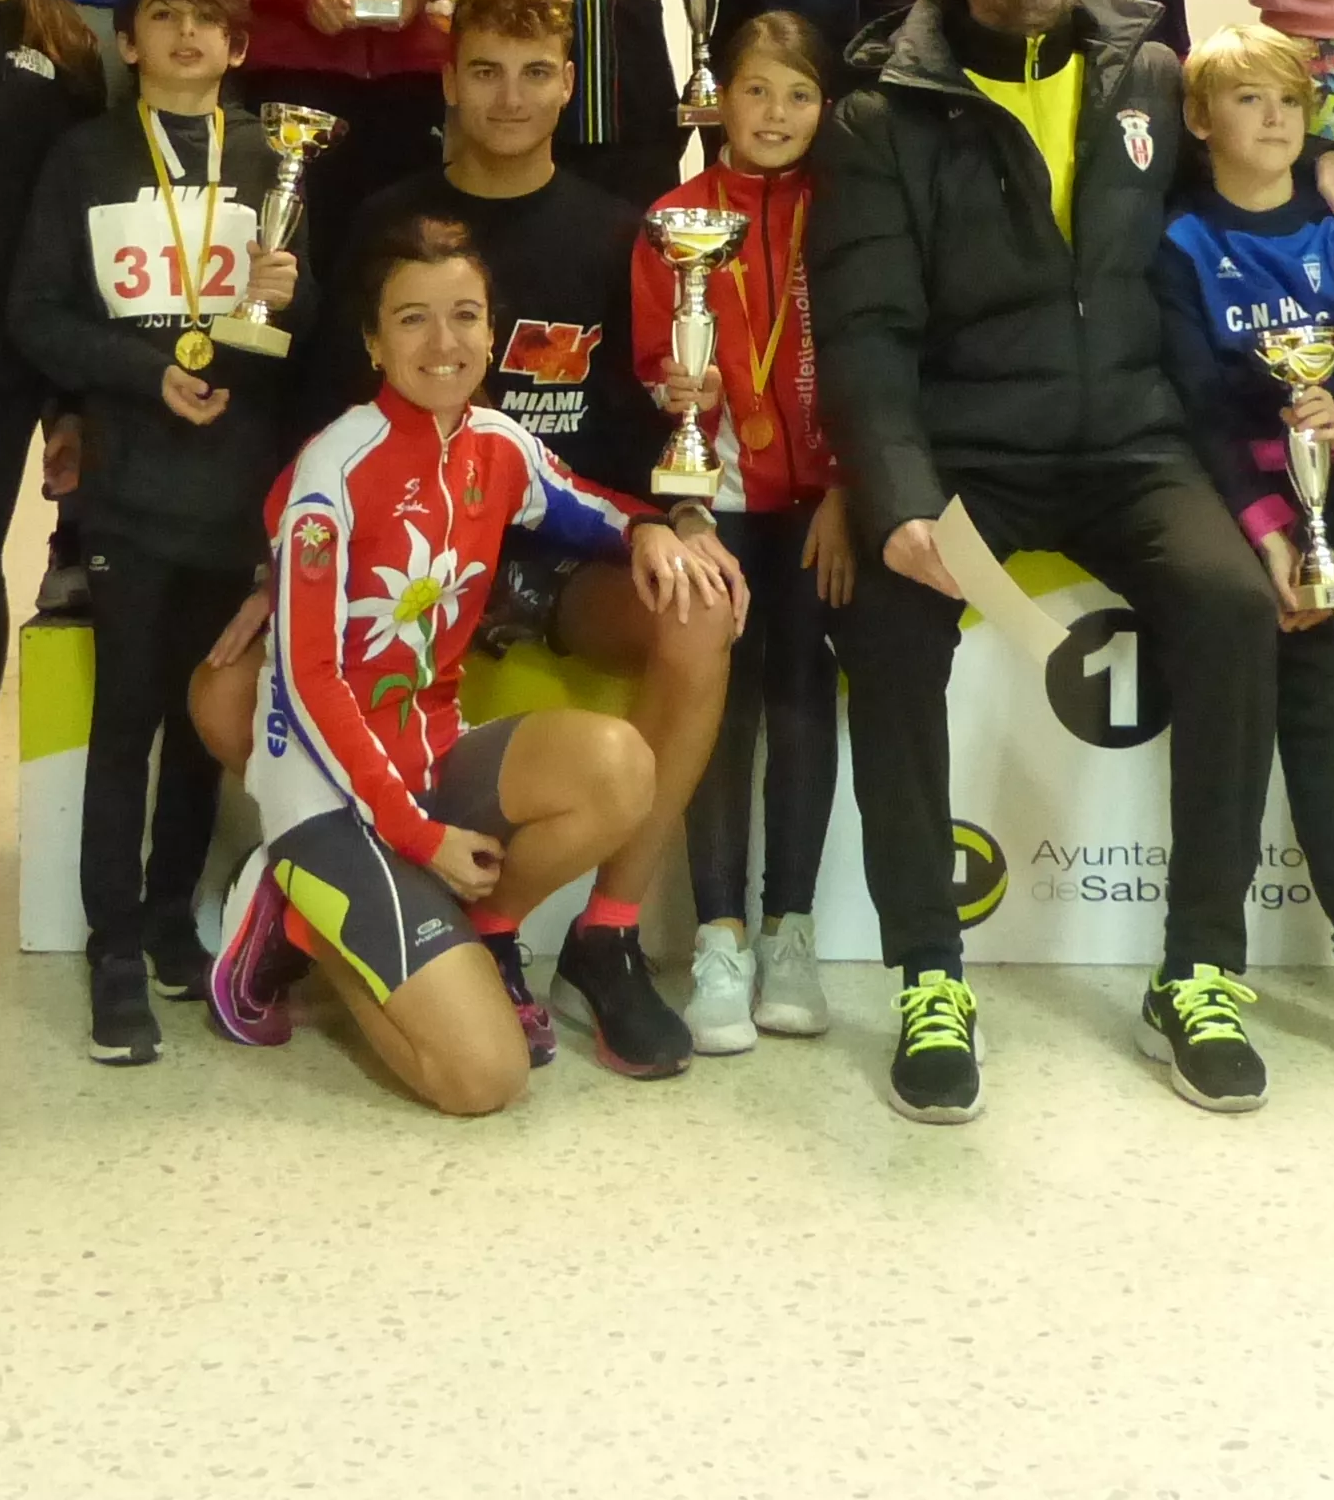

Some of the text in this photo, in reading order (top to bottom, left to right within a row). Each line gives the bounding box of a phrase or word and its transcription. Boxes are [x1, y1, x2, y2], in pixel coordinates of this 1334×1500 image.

[113, 244, 236, 299] 312
[501, 390, 584, 412] MIAMI
[518, 405, 589, 434] HEAT
[1082, 630, 1138, 727] 1
[1030, 839, 1304, 872] Ayuntato
[1030, 875, 1311, 910] deSabiigo
